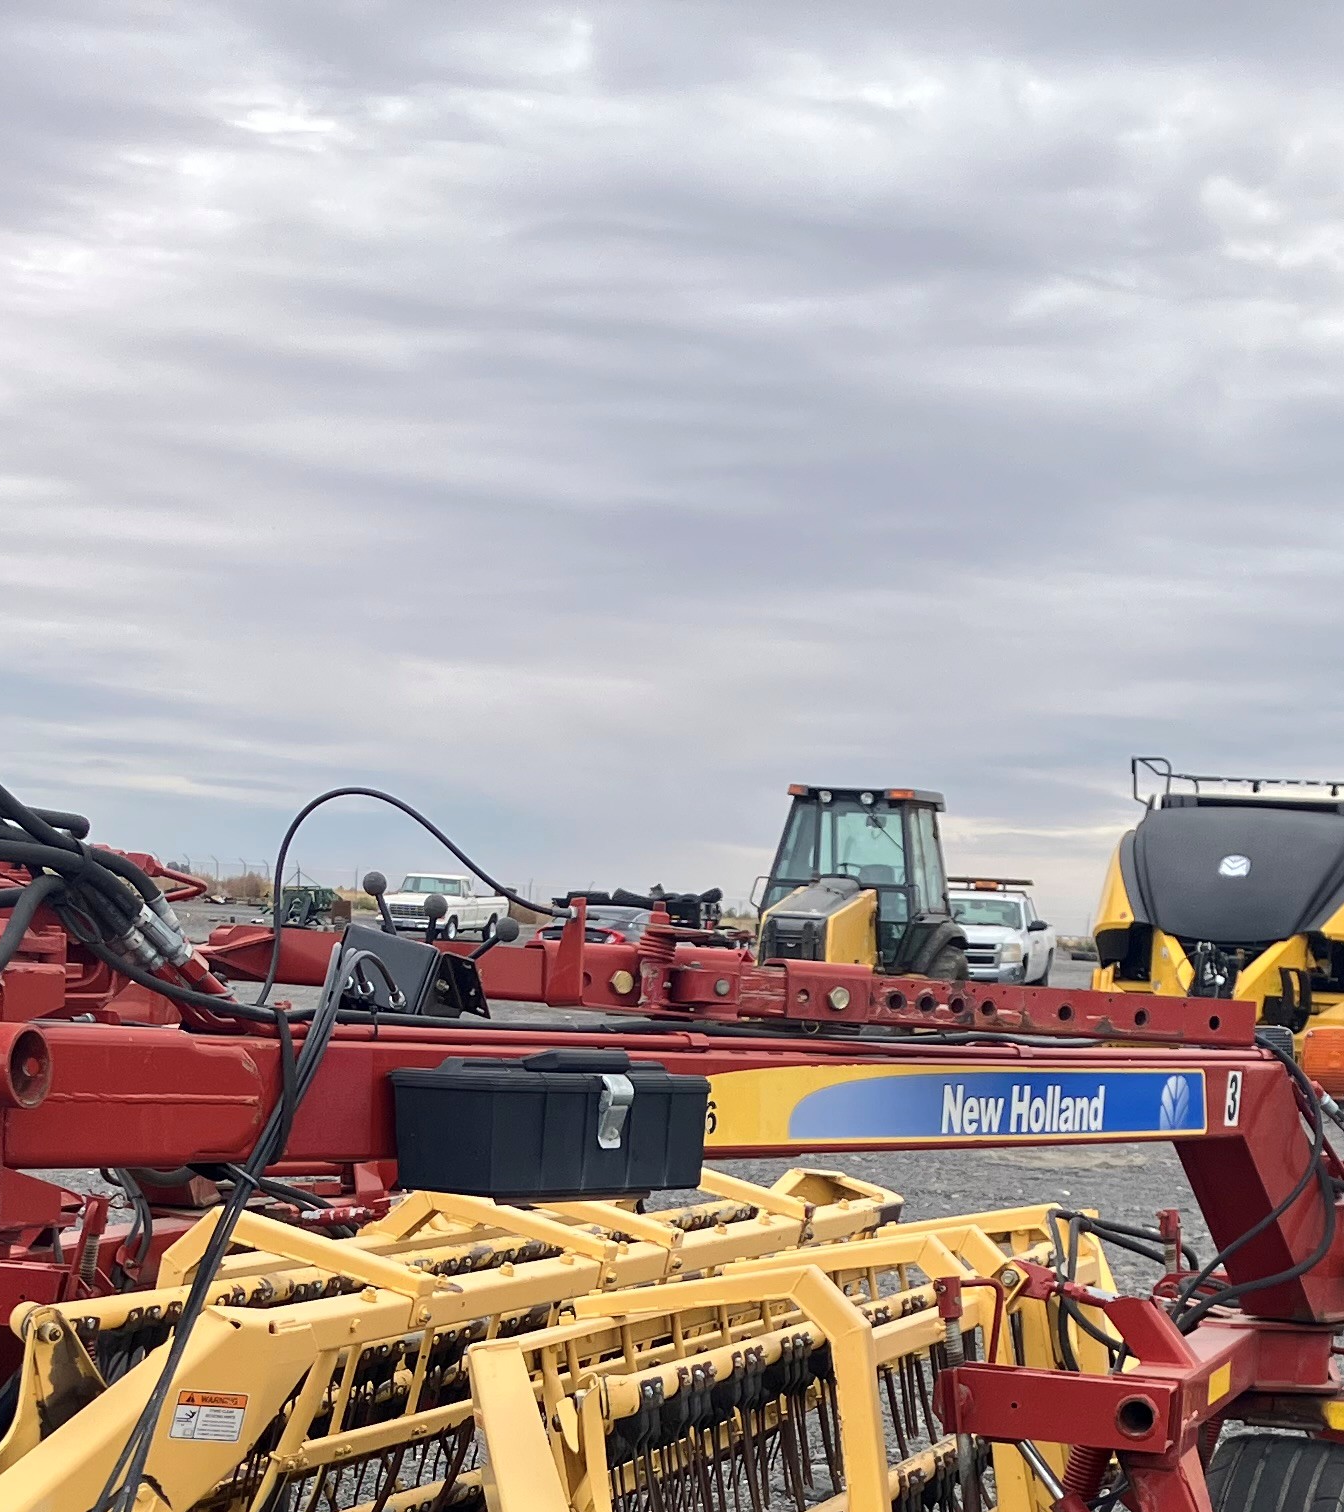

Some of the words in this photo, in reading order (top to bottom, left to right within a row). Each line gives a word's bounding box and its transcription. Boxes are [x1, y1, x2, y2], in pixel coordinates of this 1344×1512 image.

[940, 1083, 1005, 1135] New
[1009, 1084, 1106, 1133] Holland
[1227, 1074, 1239, 1121] 3
[201, 1395, 238, 1405] WARNG
